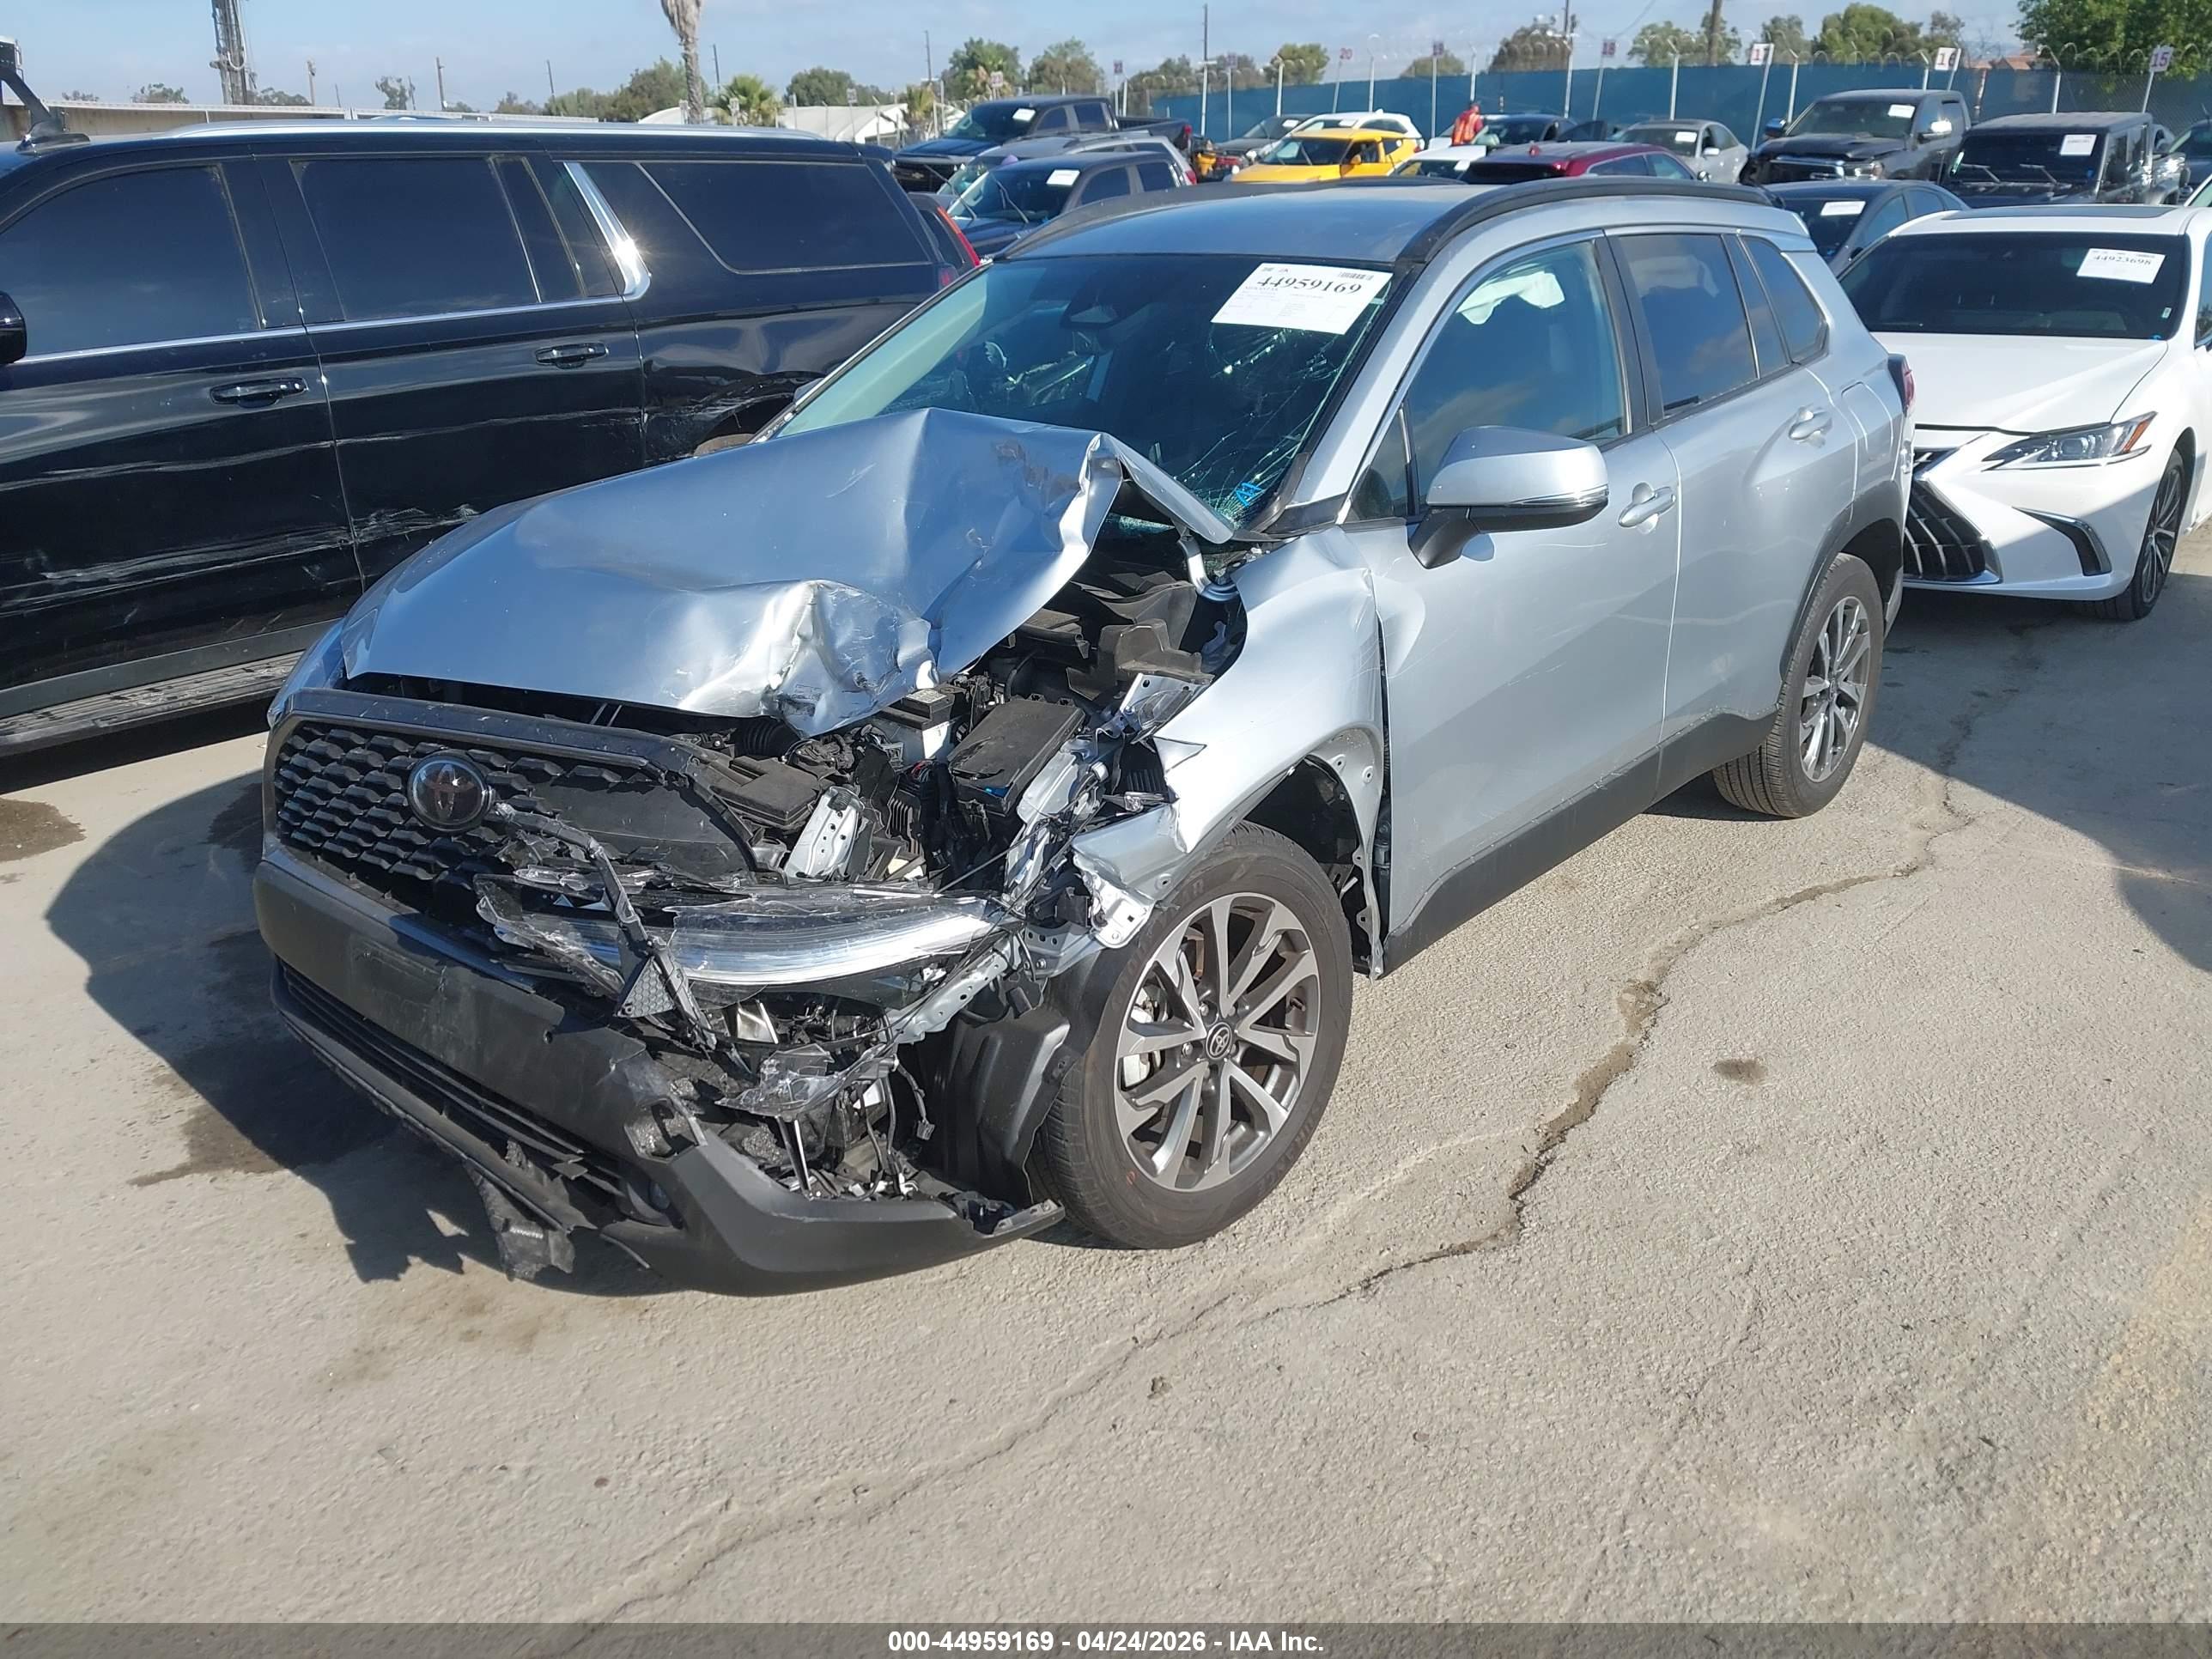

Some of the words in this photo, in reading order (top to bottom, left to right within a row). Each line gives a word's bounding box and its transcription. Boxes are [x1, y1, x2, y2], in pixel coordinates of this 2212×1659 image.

[1340, 47, 1353, 59] 20
[2151, 52, 2169, 67] 15
[2093, 255, 2152, 265] 44923698
[1256, 276, 1363, 295] 44959169
